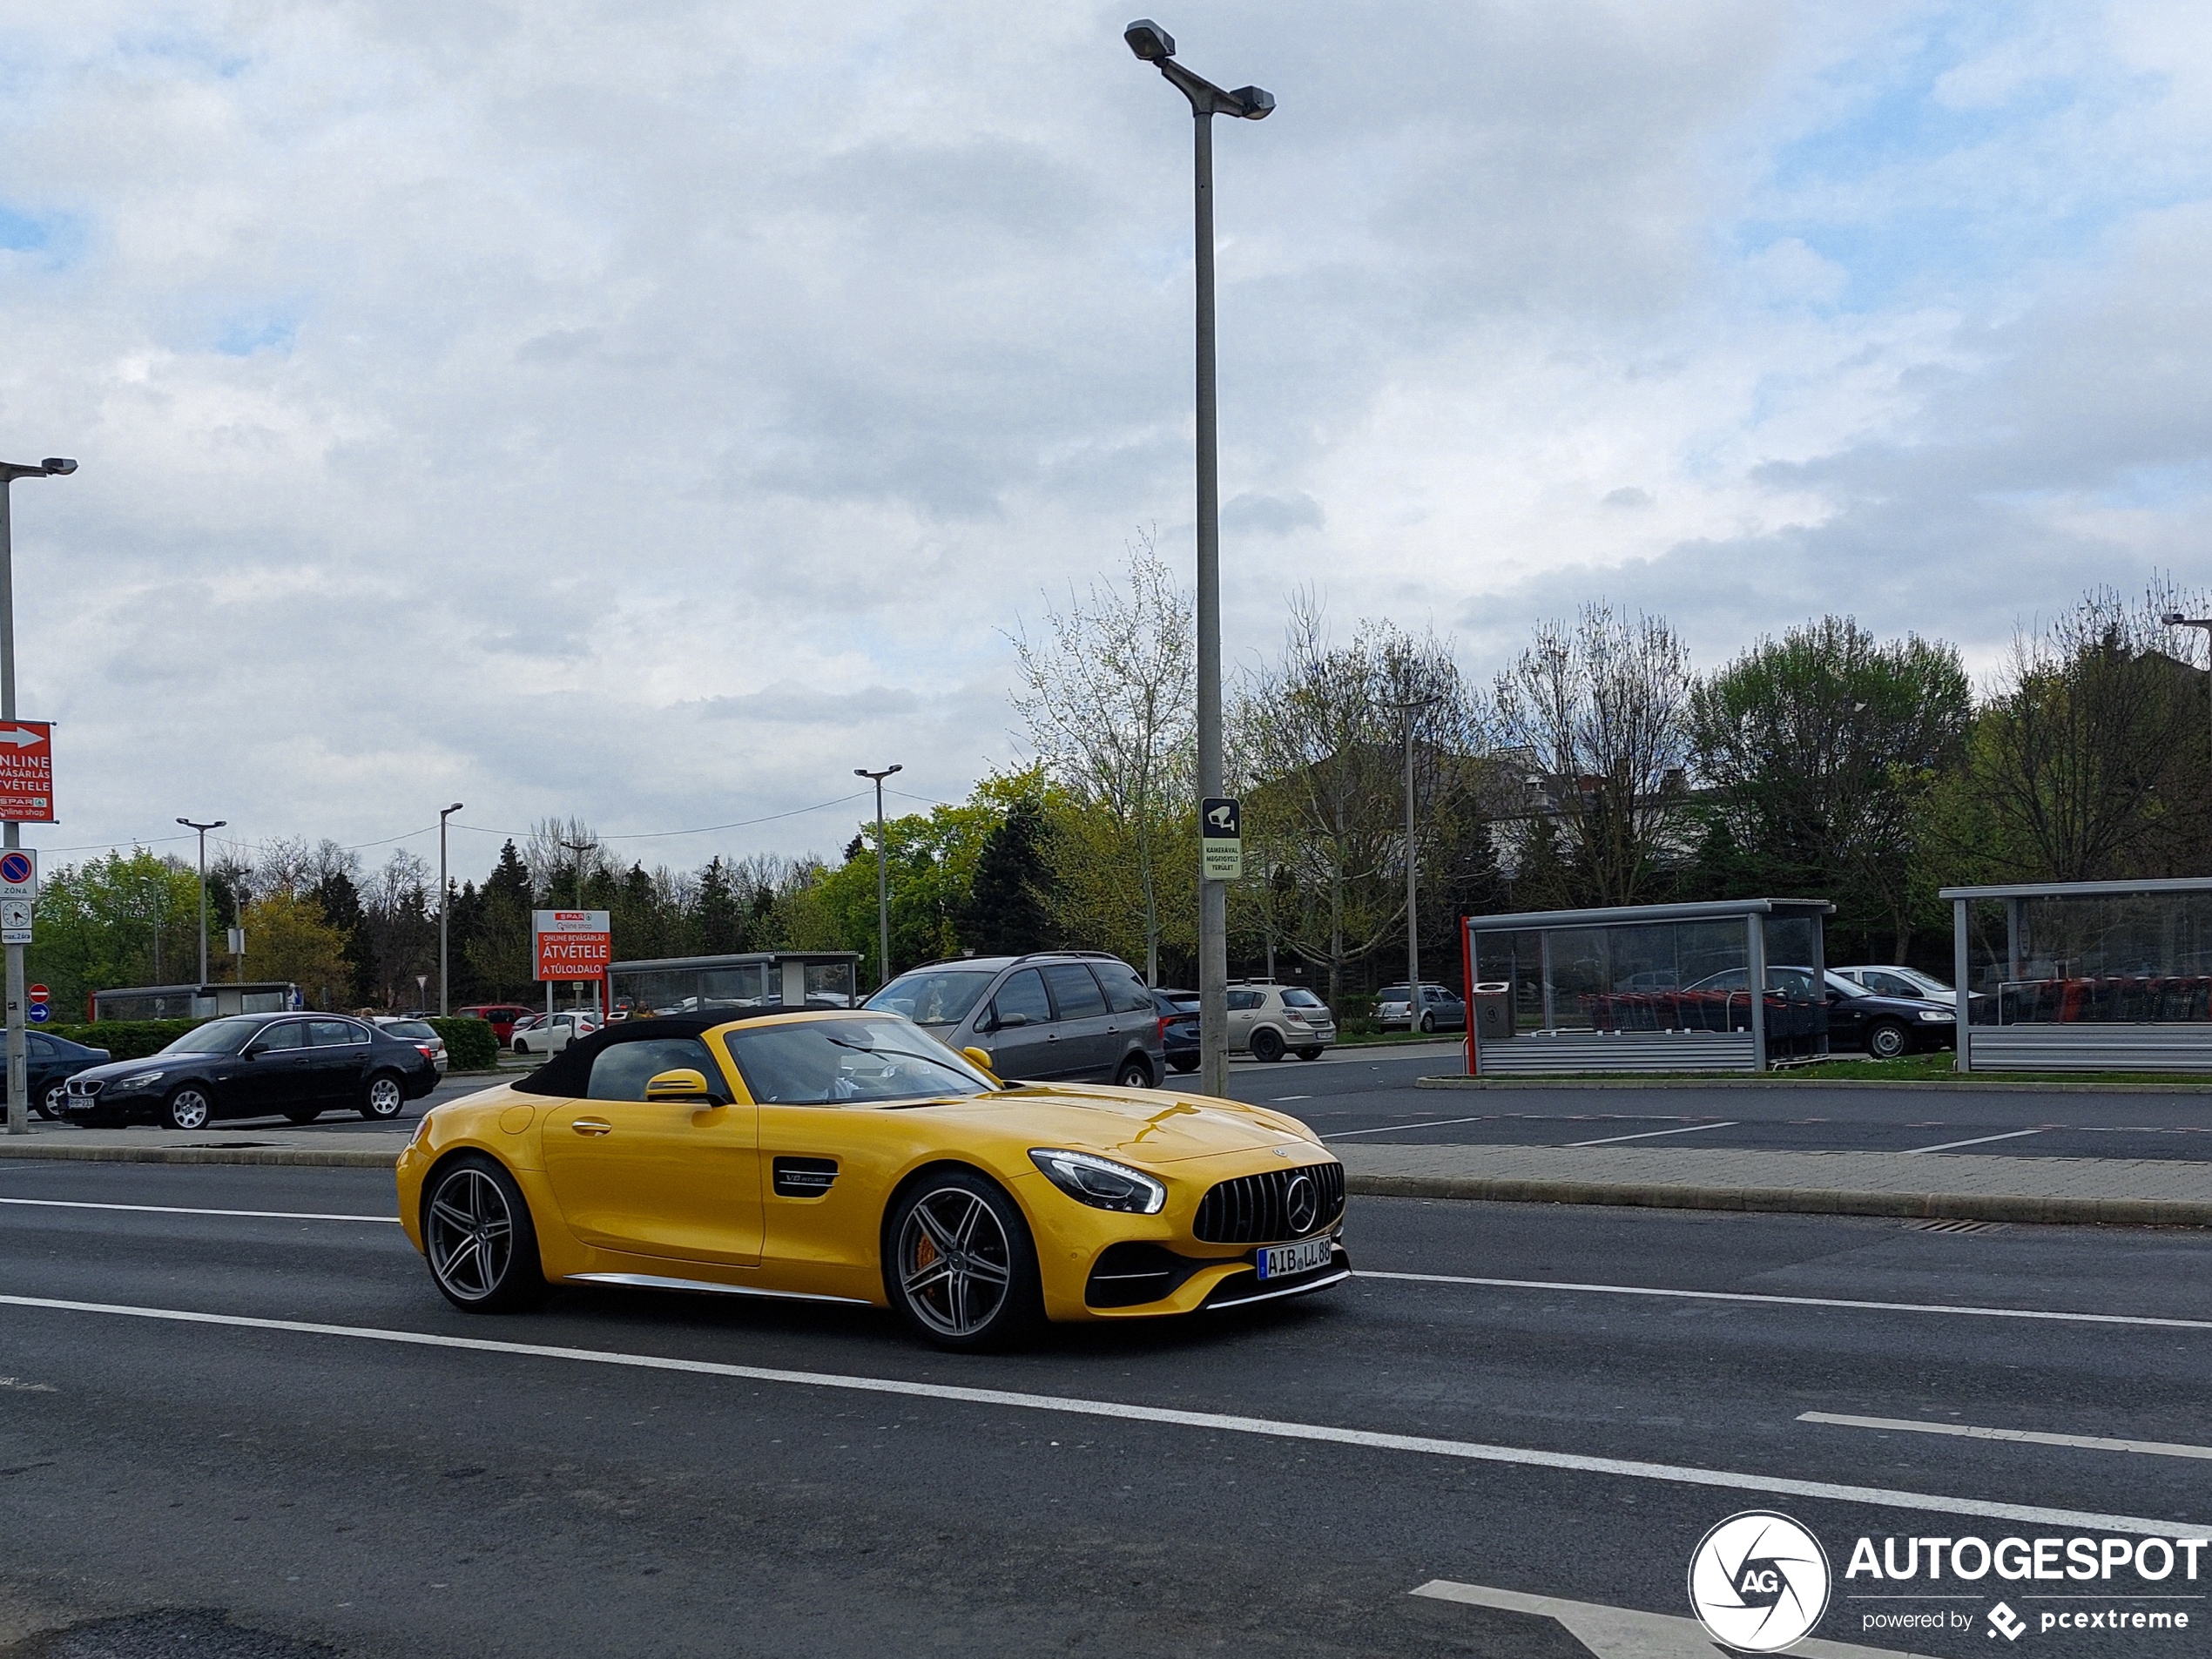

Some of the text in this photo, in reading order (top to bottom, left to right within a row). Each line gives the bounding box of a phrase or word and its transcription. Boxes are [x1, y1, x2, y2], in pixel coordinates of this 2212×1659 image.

[24, 808, 44, 817] shop
[543, 942, 607, 959] ÁTVÉTELE
[542, 963, 603, 974] A TÚLOLDALO
[1268, 1249, 1297, 1274] AIB
